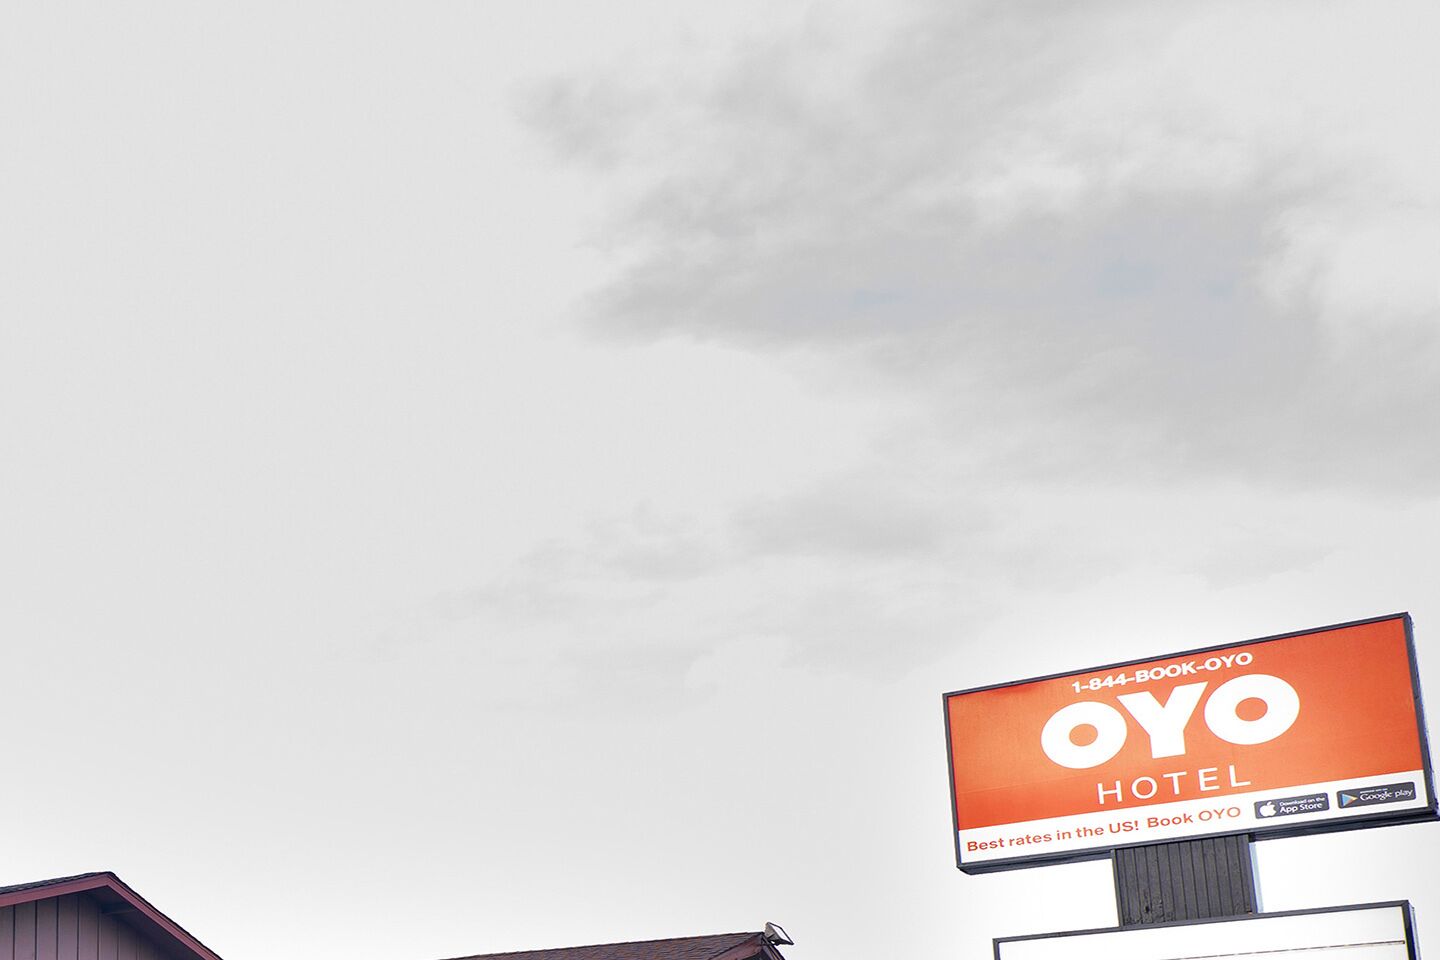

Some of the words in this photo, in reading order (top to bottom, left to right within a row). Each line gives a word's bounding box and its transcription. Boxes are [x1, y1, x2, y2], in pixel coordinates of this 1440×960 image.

[1071, 652, 1253, 693] 1-844-BOOK-OYO
[1040, 674, 1300, 769] OYO
[1097, 765, 1251, 804] HOTEL
[1279, 798, 1307, 806] Download
[1360, 791, 1392, 801] Google
[1395, 789, 1413, 798] play
[1280, 806, 1298, 814] App
[1299, 802, 1323, 811] Store
[967, 838, 1005, 852] Best
[1009, 833, 1052, 847] rates
[1056, 830, 1072, 841] in
[1076, 827, 1104, 838] the
[1109, 820, 1139, 833] US!
[1147, 813, 1194, 828] Book
[1198, 806, 1241, 821] OYO
